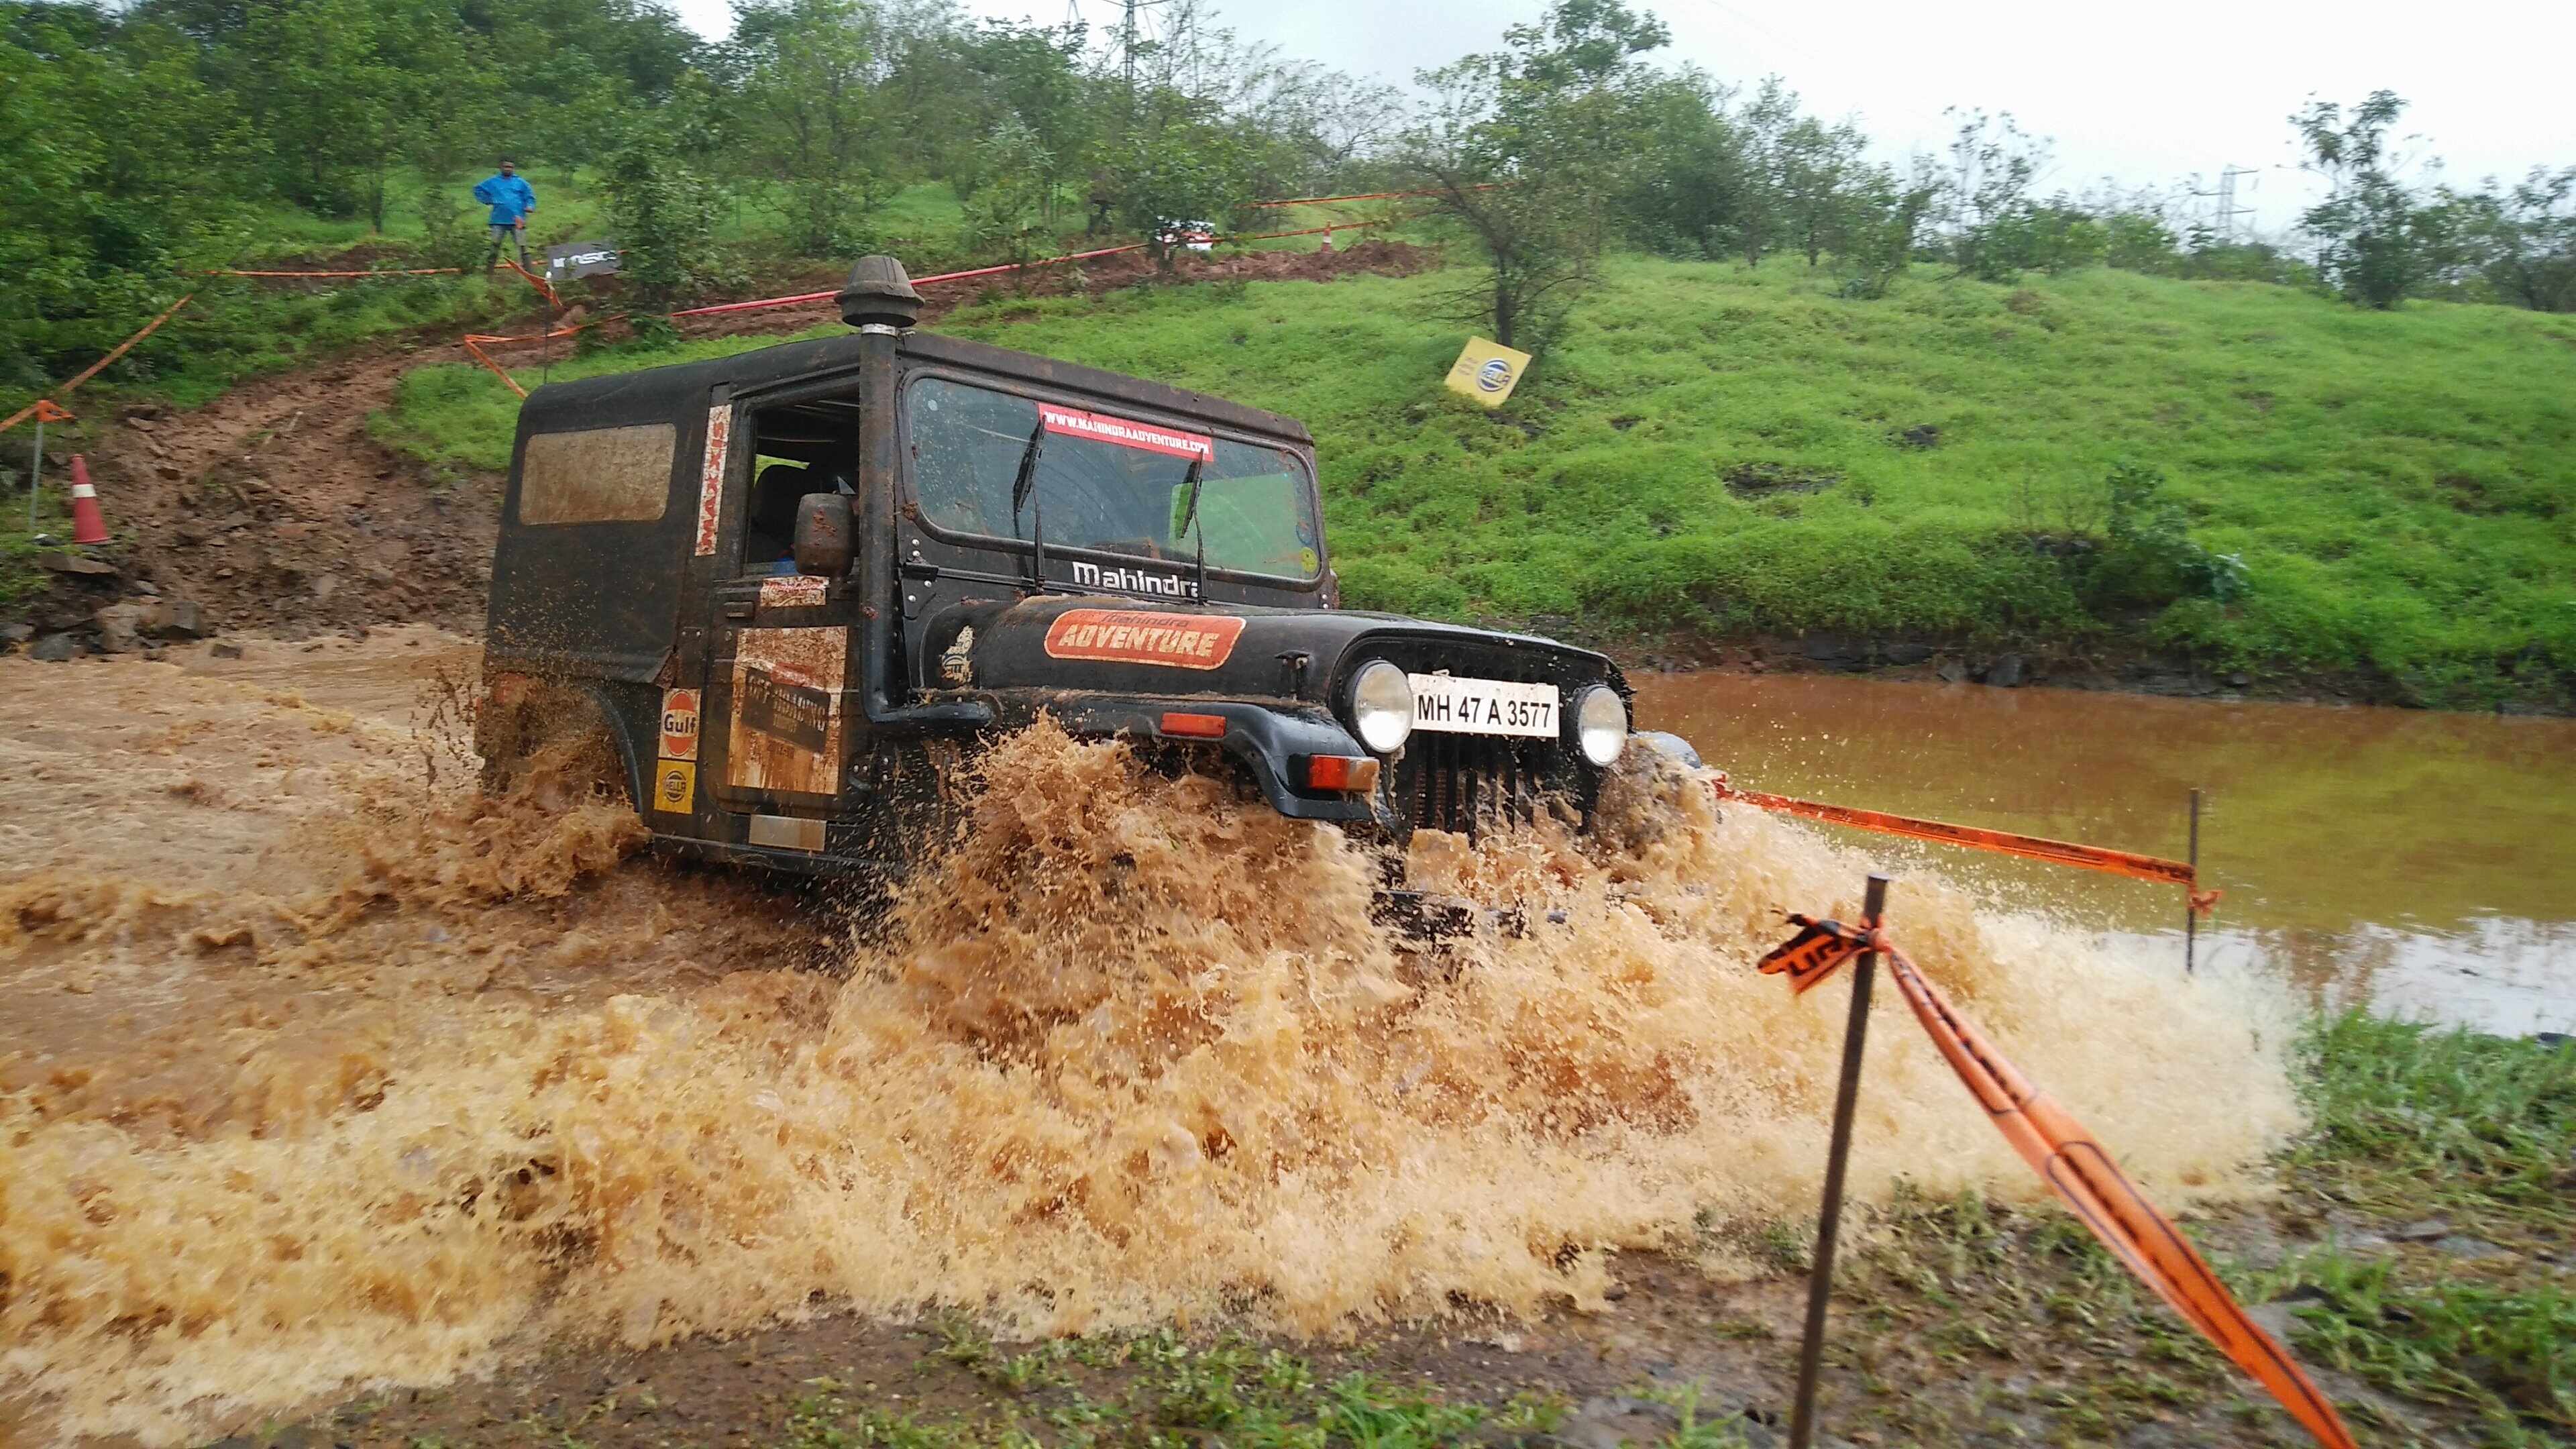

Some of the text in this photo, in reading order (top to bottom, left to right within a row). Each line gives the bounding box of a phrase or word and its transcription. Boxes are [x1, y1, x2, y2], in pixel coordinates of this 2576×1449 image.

[700, 421, 725, 549] MAXXIS
[1058, 624, 1220, 657] ADVENTURE
[664, 713, 696, 734] Gulf
[1417, 694, 1552, 728] MH 47 A 3577
[665, 780, 687, 792] HELLA
